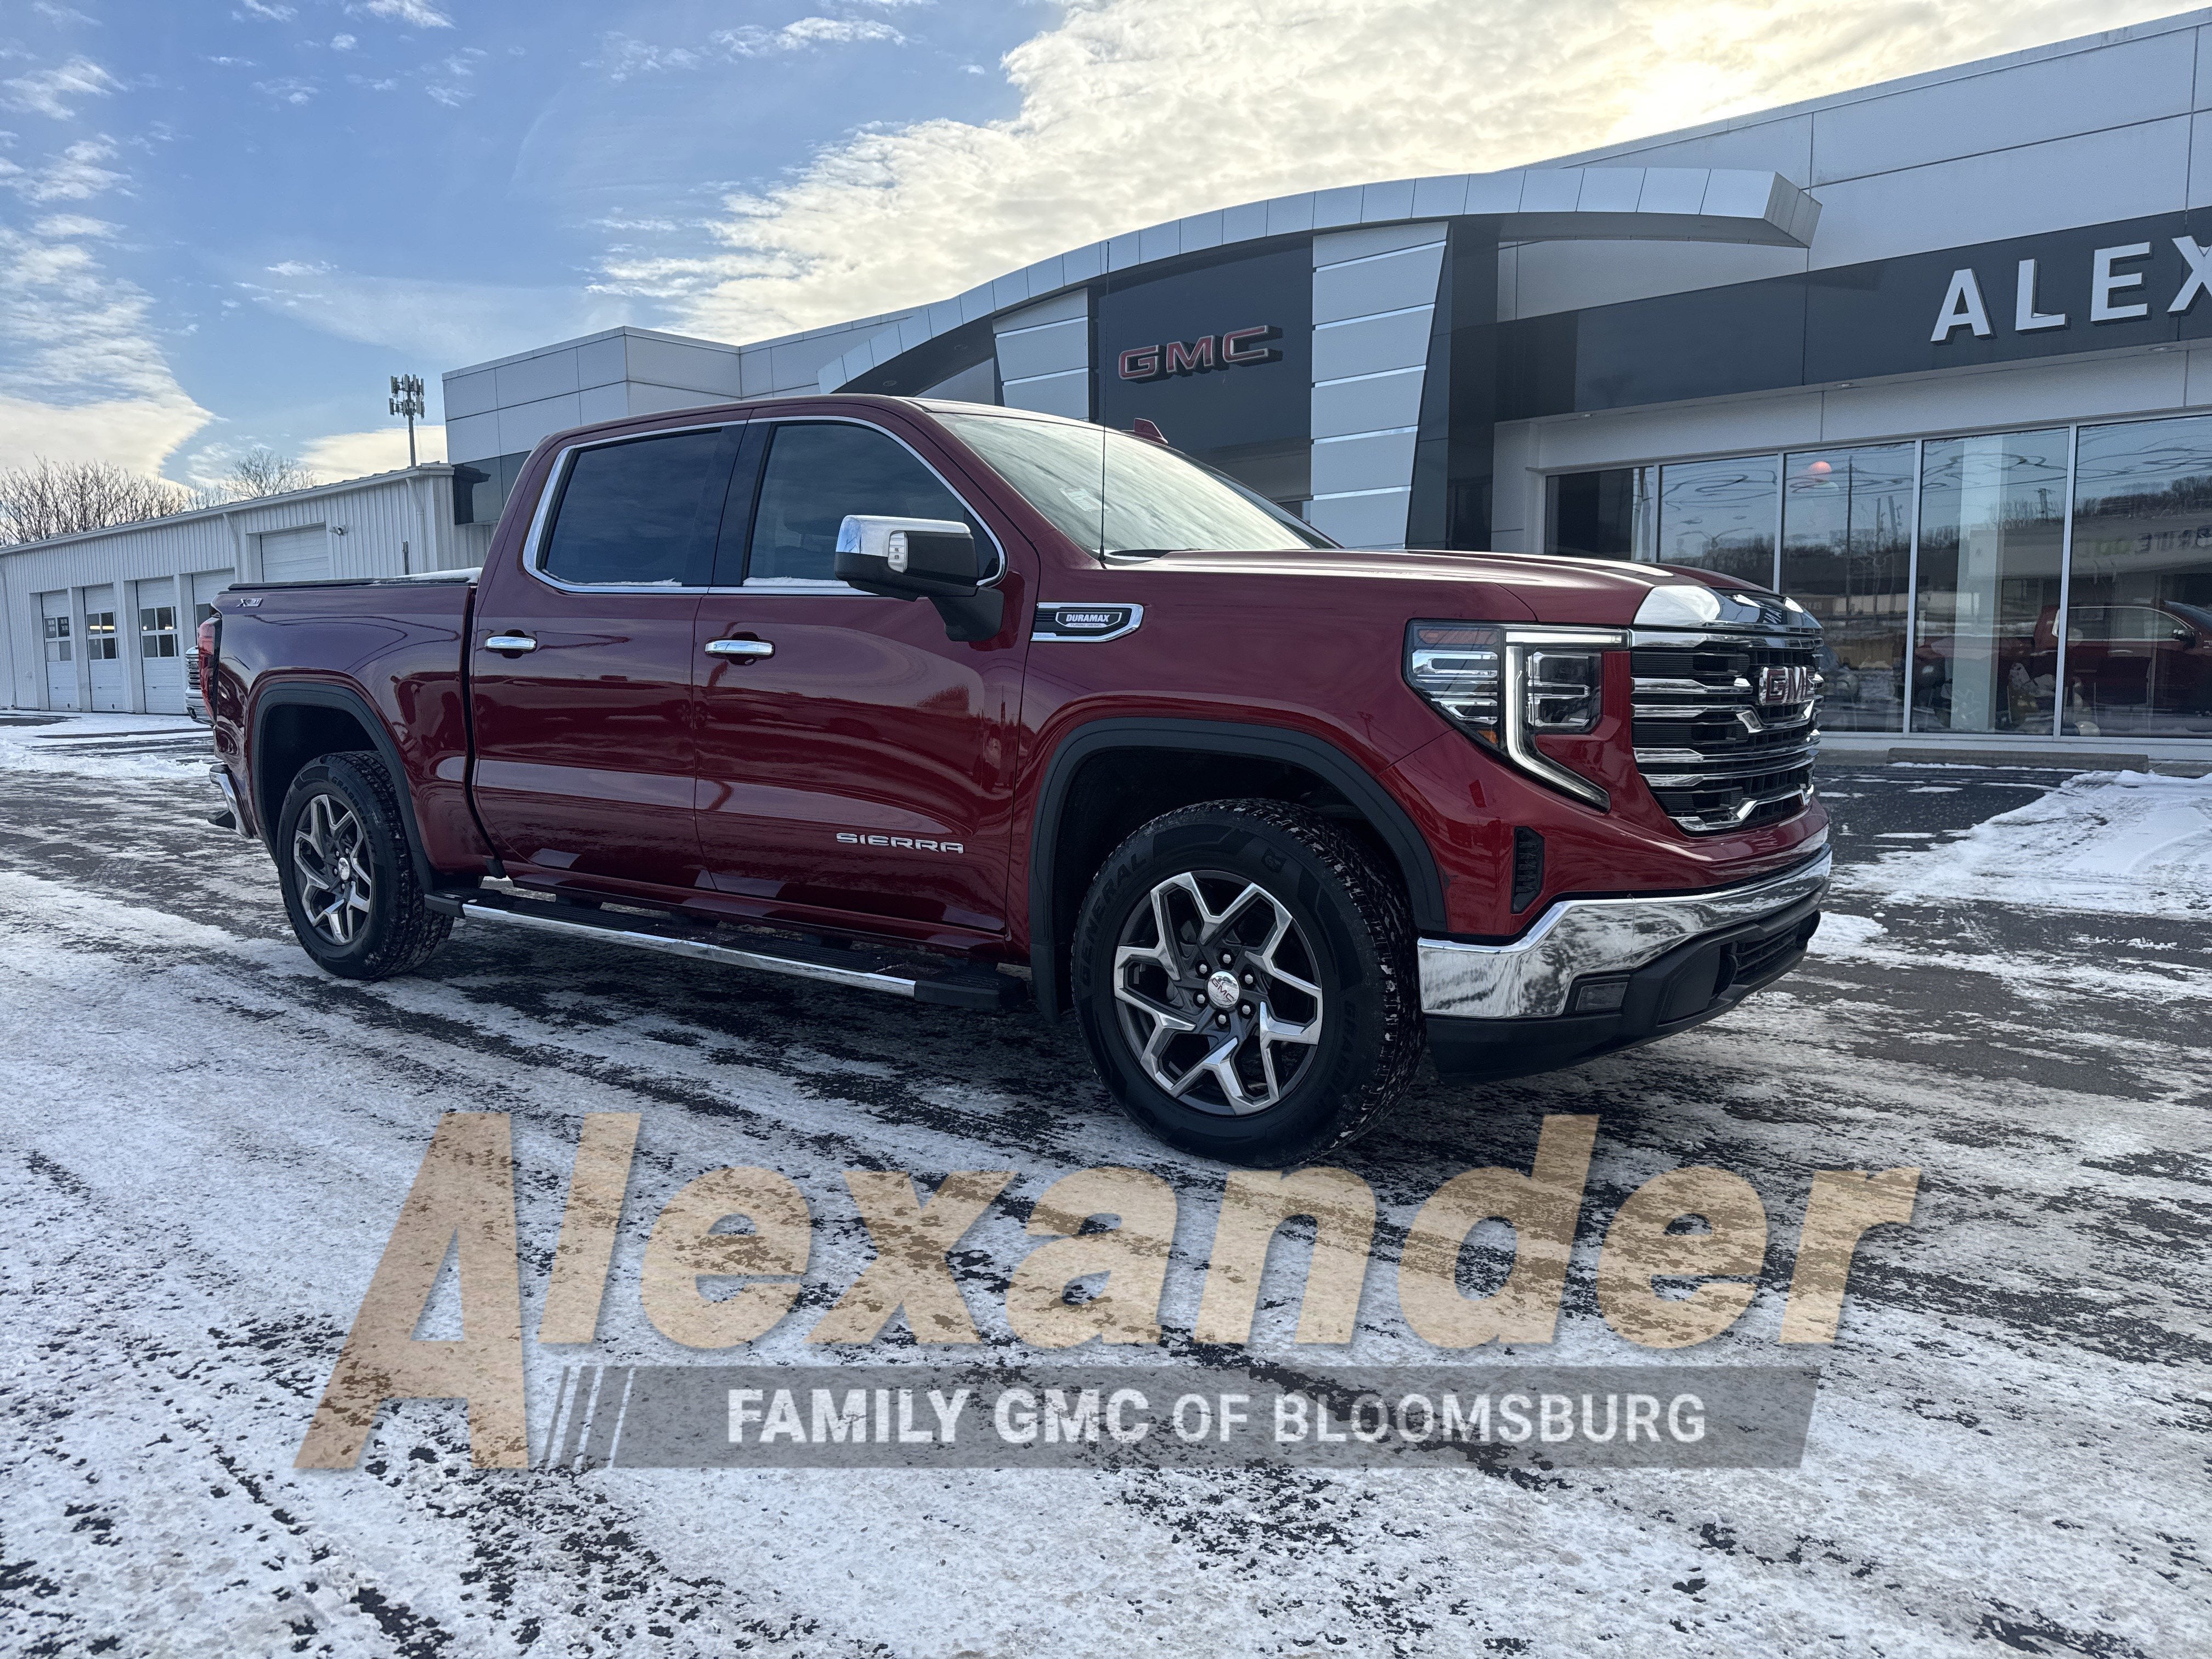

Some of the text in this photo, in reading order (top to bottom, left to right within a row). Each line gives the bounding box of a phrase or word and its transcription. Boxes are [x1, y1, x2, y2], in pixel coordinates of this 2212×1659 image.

[1930, 236, 2212, 342] ALEX
[1119, 325, 1269, 380] GMC
[1065, 614, 1110, 622] DURAMAX
[331, 776, 368, 824] GRABBER
[836, 833, 964, 854] SIERRA
[1079, 854, 1147, 986] GENERAL
[1211, 977, 1235, 1003] GMC
